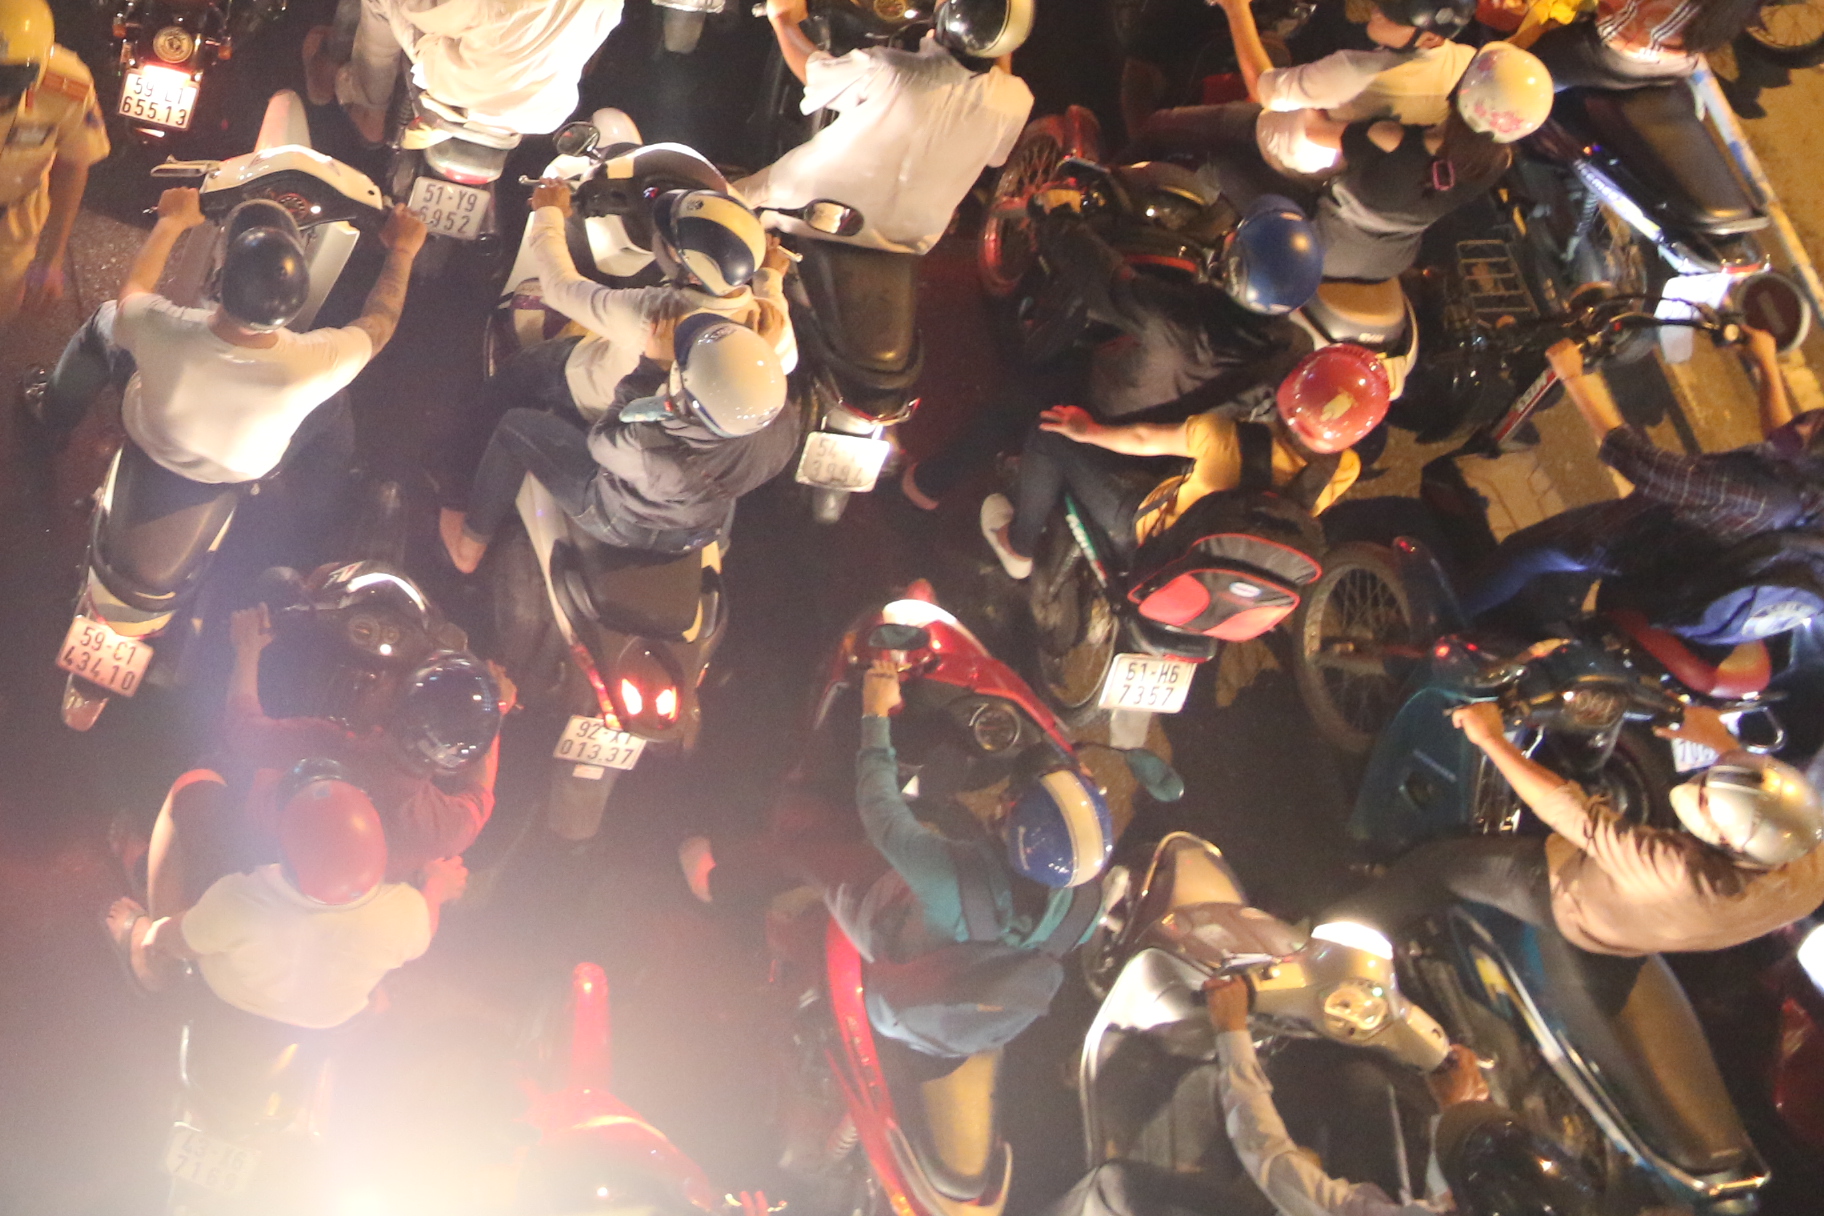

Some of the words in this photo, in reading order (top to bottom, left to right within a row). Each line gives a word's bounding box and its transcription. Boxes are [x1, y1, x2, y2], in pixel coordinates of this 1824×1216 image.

[133, 77, 184, 105] 59L1
[122, 96, 187, 126] 655.13
[423, 183, 478, 213] 51-Y9
[419, 206, 470, 234] 6952
[80, 626, 136, 664] 59-C1
[62, 646, 136, 691] 434.10
[1118, 684, 1174, 706] 7357
[560, 739, 634, 764] 013.37
